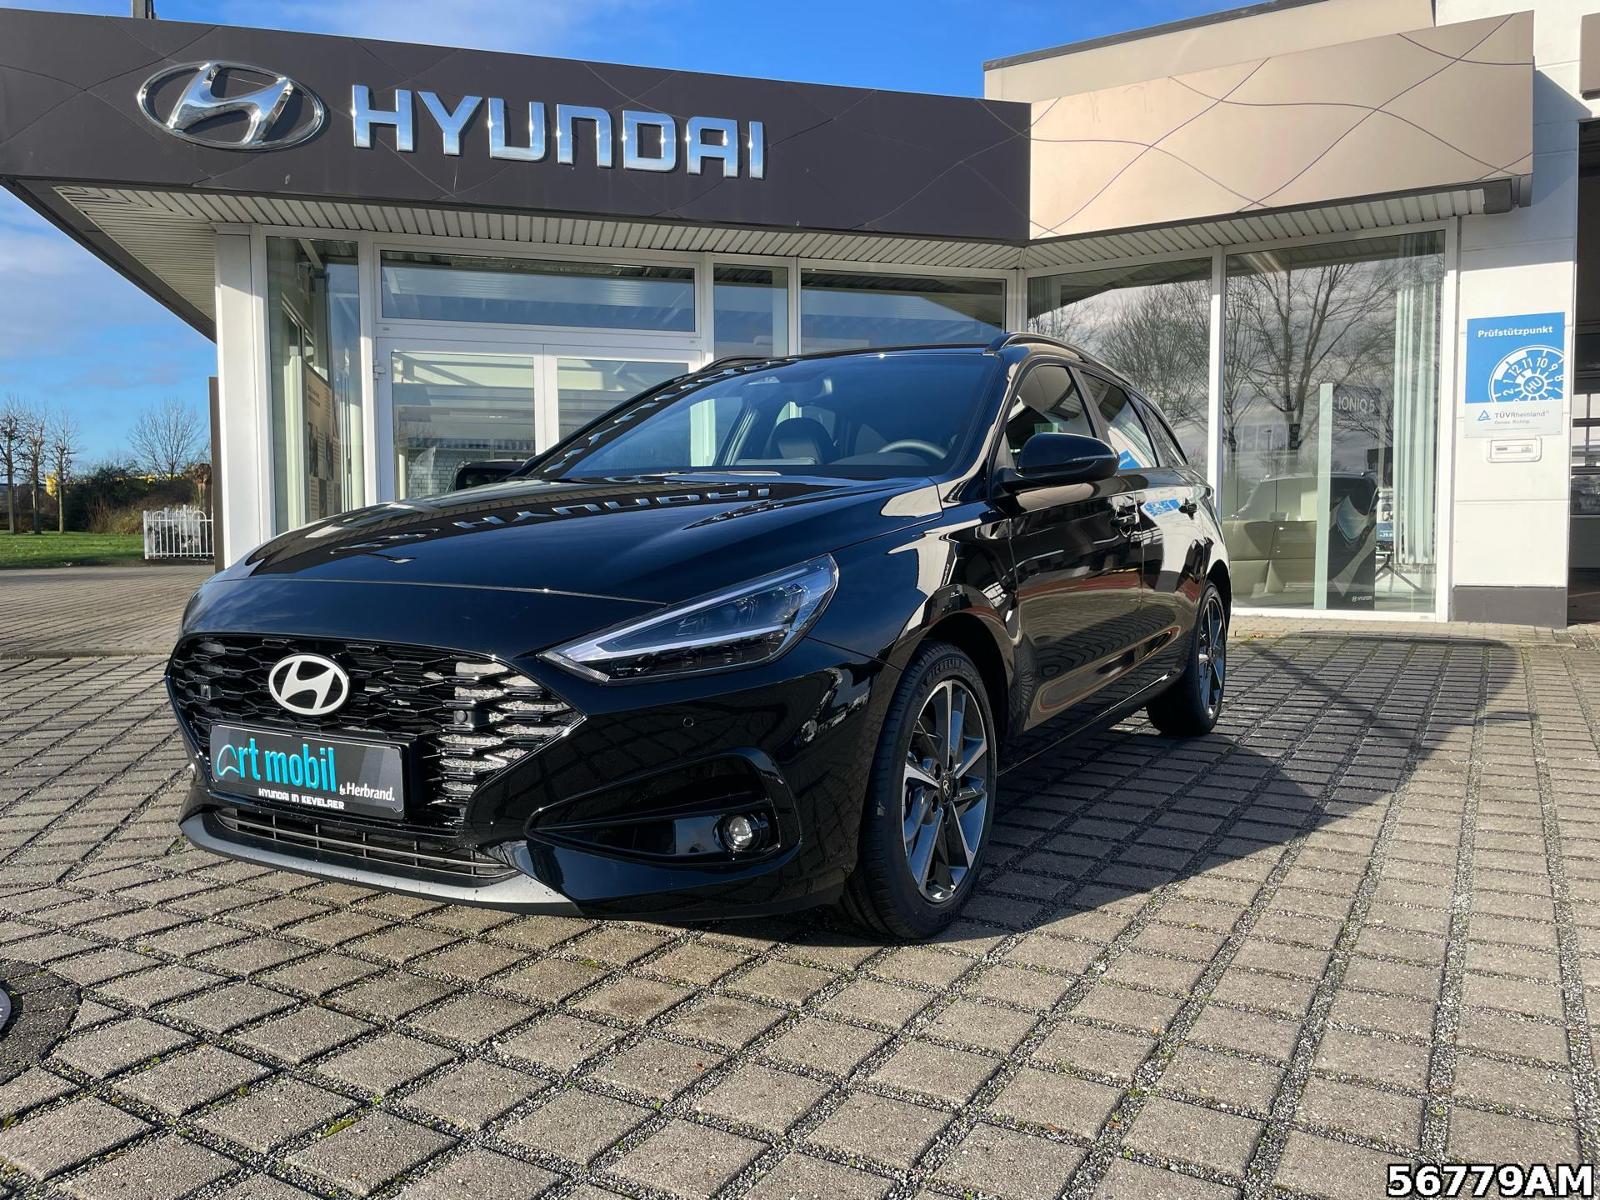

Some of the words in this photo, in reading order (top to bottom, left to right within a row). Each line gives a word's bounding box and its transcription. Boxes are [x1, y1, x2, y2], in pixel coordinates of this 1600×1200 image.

[352, 84, 767, 179] HYUNDAI
[1477, 326, 1553, 338] Prüfstützpunkt
[1508, 365, 1523, 376] 12
[1522, 358, 1533, 369] 11
[1536, 357, 1548, 368] 10
[1549, 363, 1558, 371] 9
[1525, 377, 1542, 393] HU
[1338, 396, 1367, 414] IONIQ
[1369, 399, 1375, 412] 5
[265, 743, 337, 792] mobil
[346, 781, 395, 802] Herbrand.
[258, 787, 290, 802] HYUNDAI
[301, 795, 345, 810] KEVELAER
